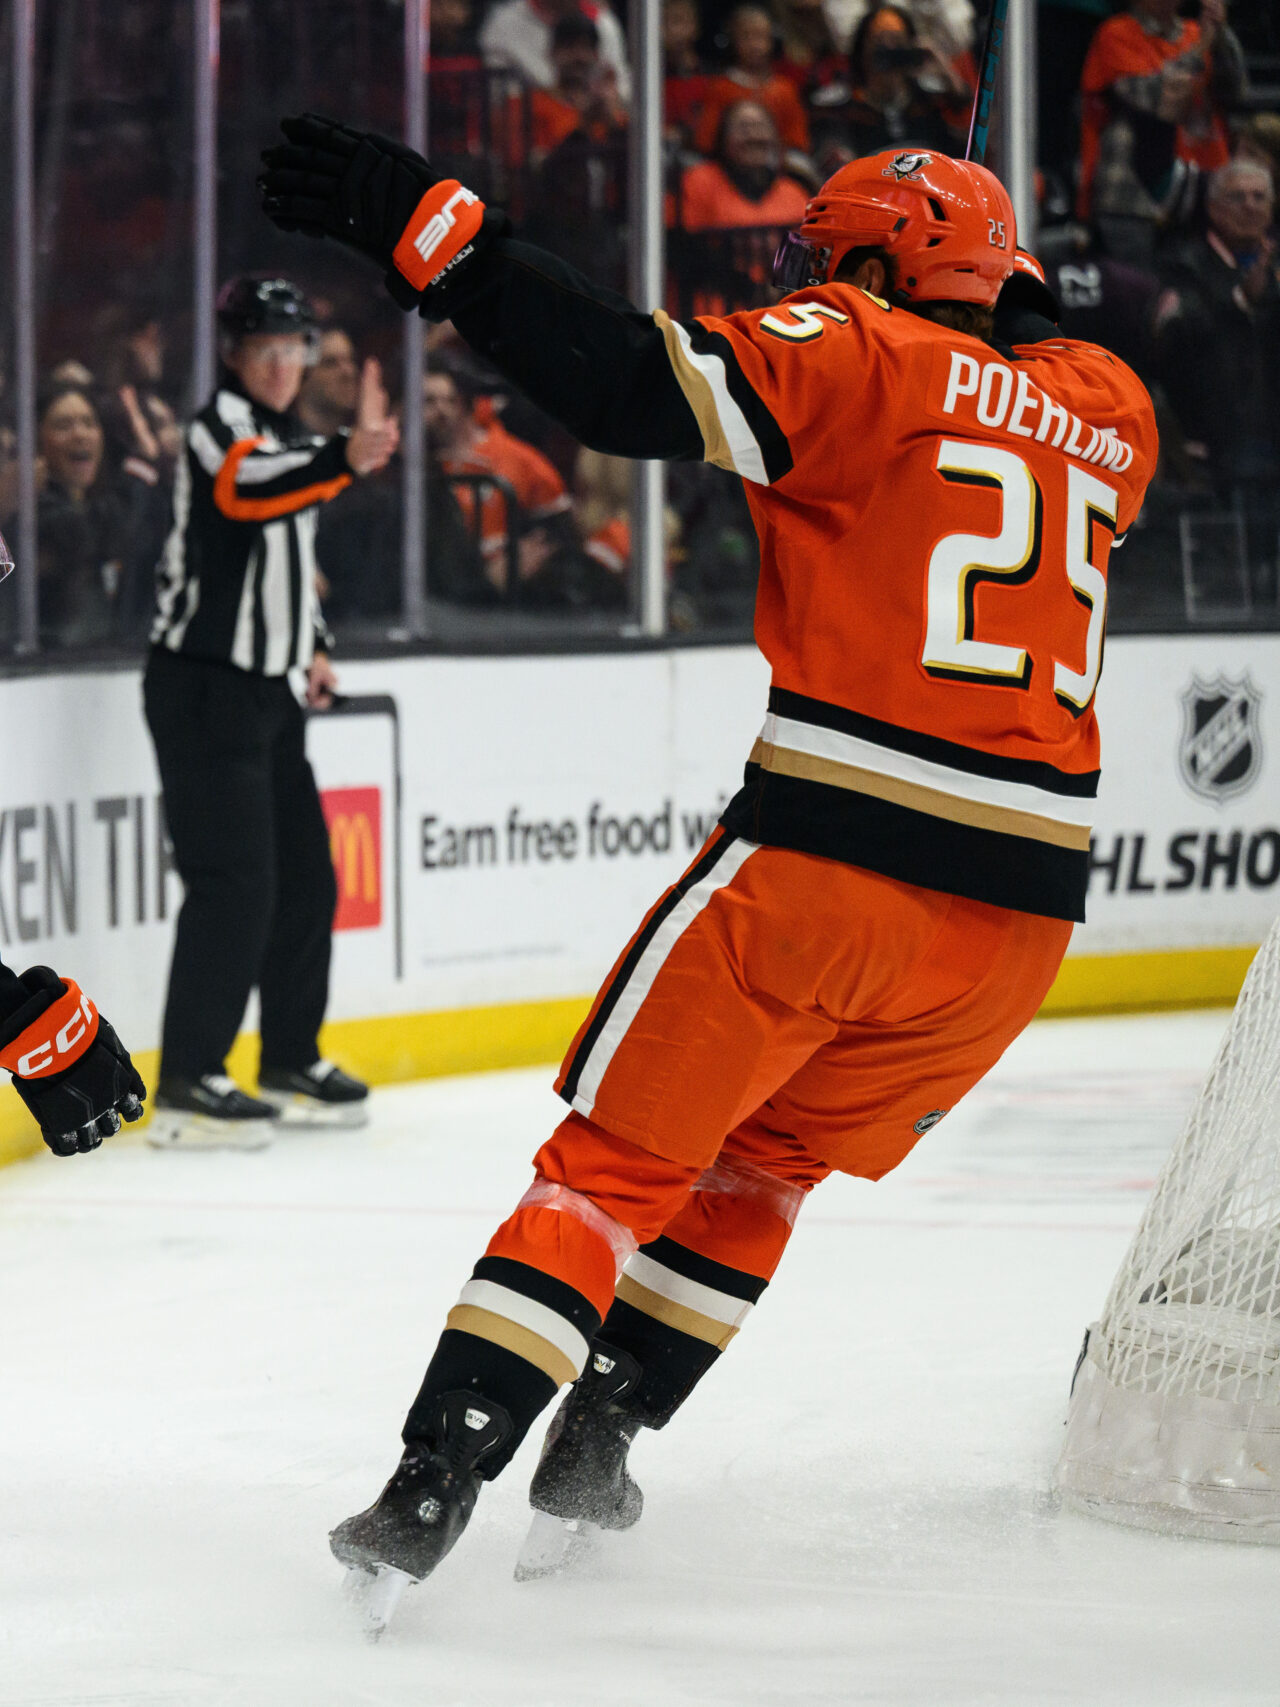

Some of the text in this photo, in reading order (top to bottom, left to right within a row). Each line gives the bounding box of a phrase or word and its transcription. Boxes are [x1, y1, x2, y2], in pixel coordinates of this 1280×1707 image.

[988, 218, 1006, 248] 25
[921, 438, 1119, 720] 25
[421, 814, 496, 870] Earn
[508, 805, 576, 866] free
[588, 800, 673, 856] food
[1089, 829, 1280, 893] HLSHO
